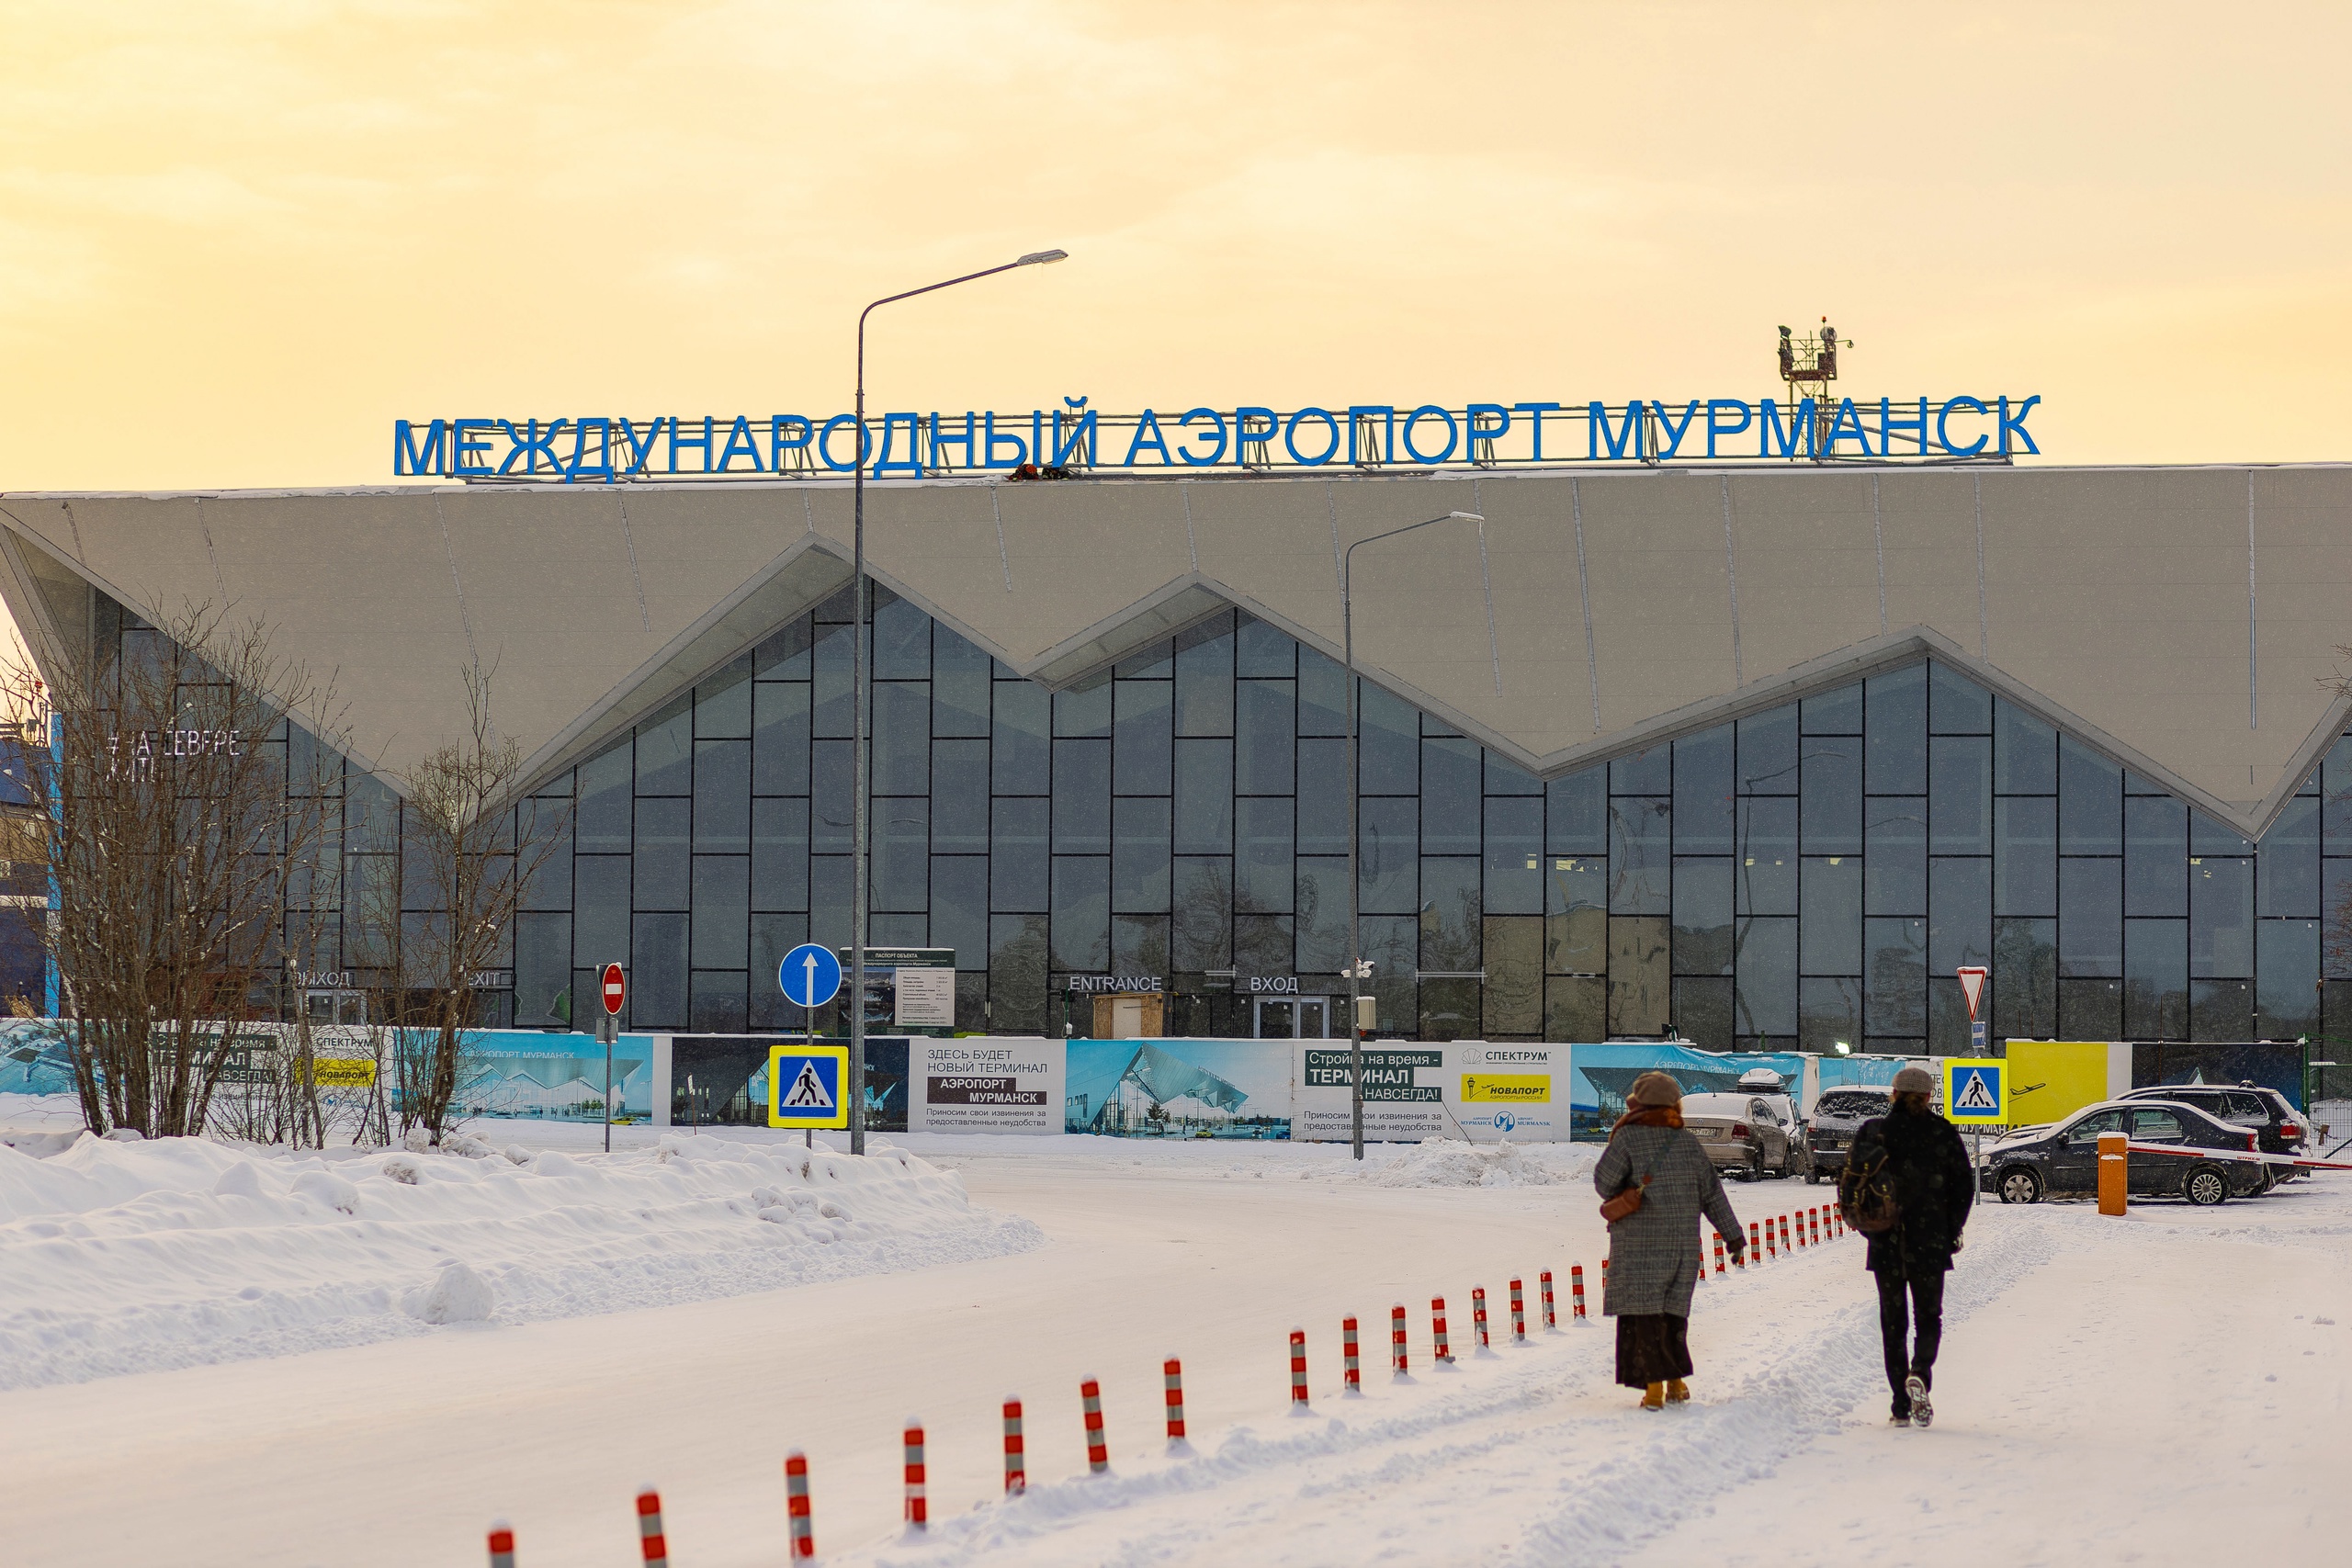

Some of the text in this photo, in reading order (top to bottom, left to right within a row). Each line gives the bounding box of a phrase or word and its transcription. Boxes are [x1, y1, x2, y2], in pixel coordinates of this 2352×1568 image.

[394, 395, 2041, 485] МЕЖДУНАРОДНЫЙ АЭРОПОРТ МУРМАНСК
[1069, 976, 1162, 991] ENTRANCE
[1250, 976, 1298, 994] ВХОД
[316, 1037, 373, 1047] СПЕКТРУМ
[154, 1049, 246, 1066] ТЕМИАЛ
[523, 1051, 575, 1059] МУРМАНСК
[927, 1049, 1012, 1062] ЗДЕСЬ БУДЕТ
[1309, 1052, 1363, 1066] Стройа
[1368, 1055, 1385, 1065] на
[1388, 1055, 1430, 1067] время
[1485, 1051, 1548, 1061] СПЕКТРУМ
[927, 1061, 1047, 1073] НОВЫЙ ТЕРМИНАЛ
[212, 1069, 273, 1084] АВСЕГДА!
[1309, 1068, 1408, 1084] ТЕРМИНАЛ
[940, 1078, 1007, 1089] АЭРОПОРТ
[1364, 1088, 1439, 1102] НАВСЕГДА!
[1490, 1087, 1545, 1095] НОВАПОРТ
[969, 1092, 1037, 1103] МУРМАНСК
[926, 1108, 967, 1117] Приносим
[1304, 1111, 1351, 1121] Приносим
[1000, 1119, 1046, 1127] неудобства
[1304, 1122, 1442, 1133] предоставлнные неудобства
[1958, 1123, 2007, 1134] МУМАН
